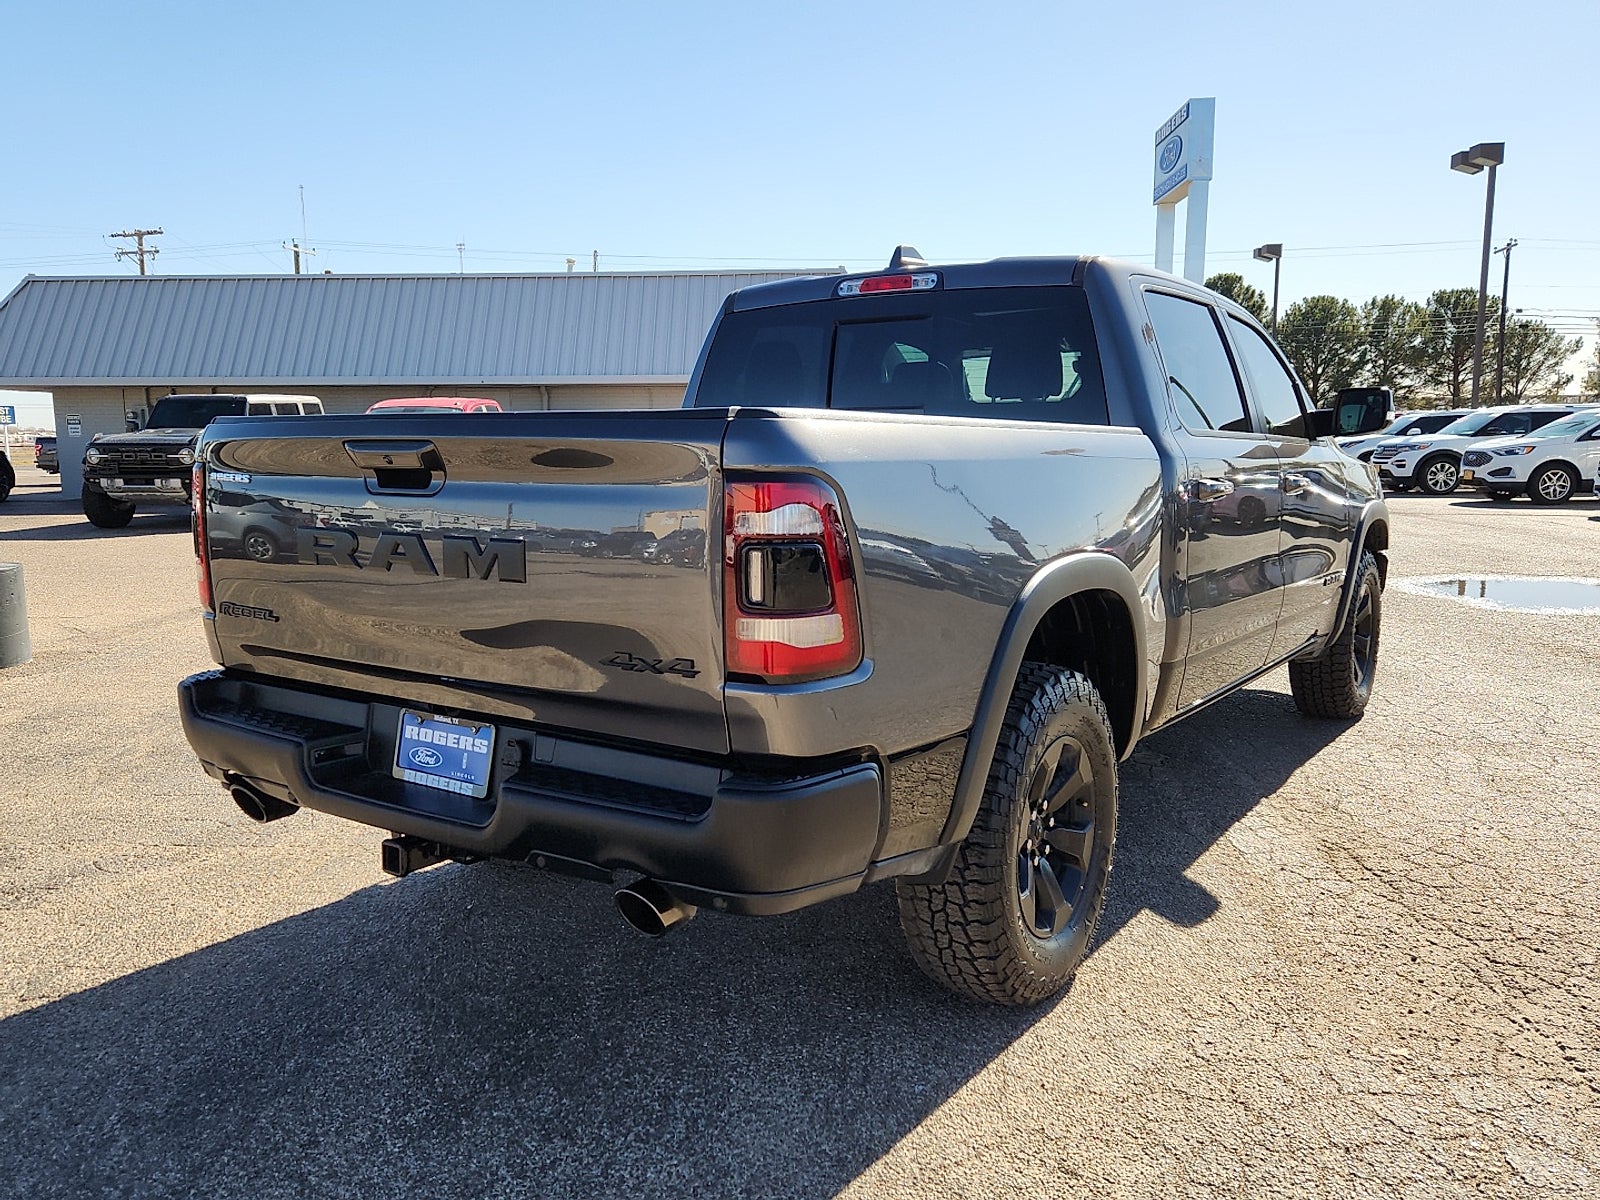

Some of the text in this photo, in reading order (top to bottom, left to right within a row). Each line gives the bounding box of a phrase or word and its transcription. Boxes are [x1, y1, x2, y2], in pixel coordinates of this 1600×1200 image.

[108, 452, 166, 460] FORD
[296, 526, 527, 584] RAM
[220, 601, 280, 622] REBEL
[404, 725, 488, 754] ROGERS
[415, 748, 436, 765] Ford
[403, 769, 473, 796] ROGERS
